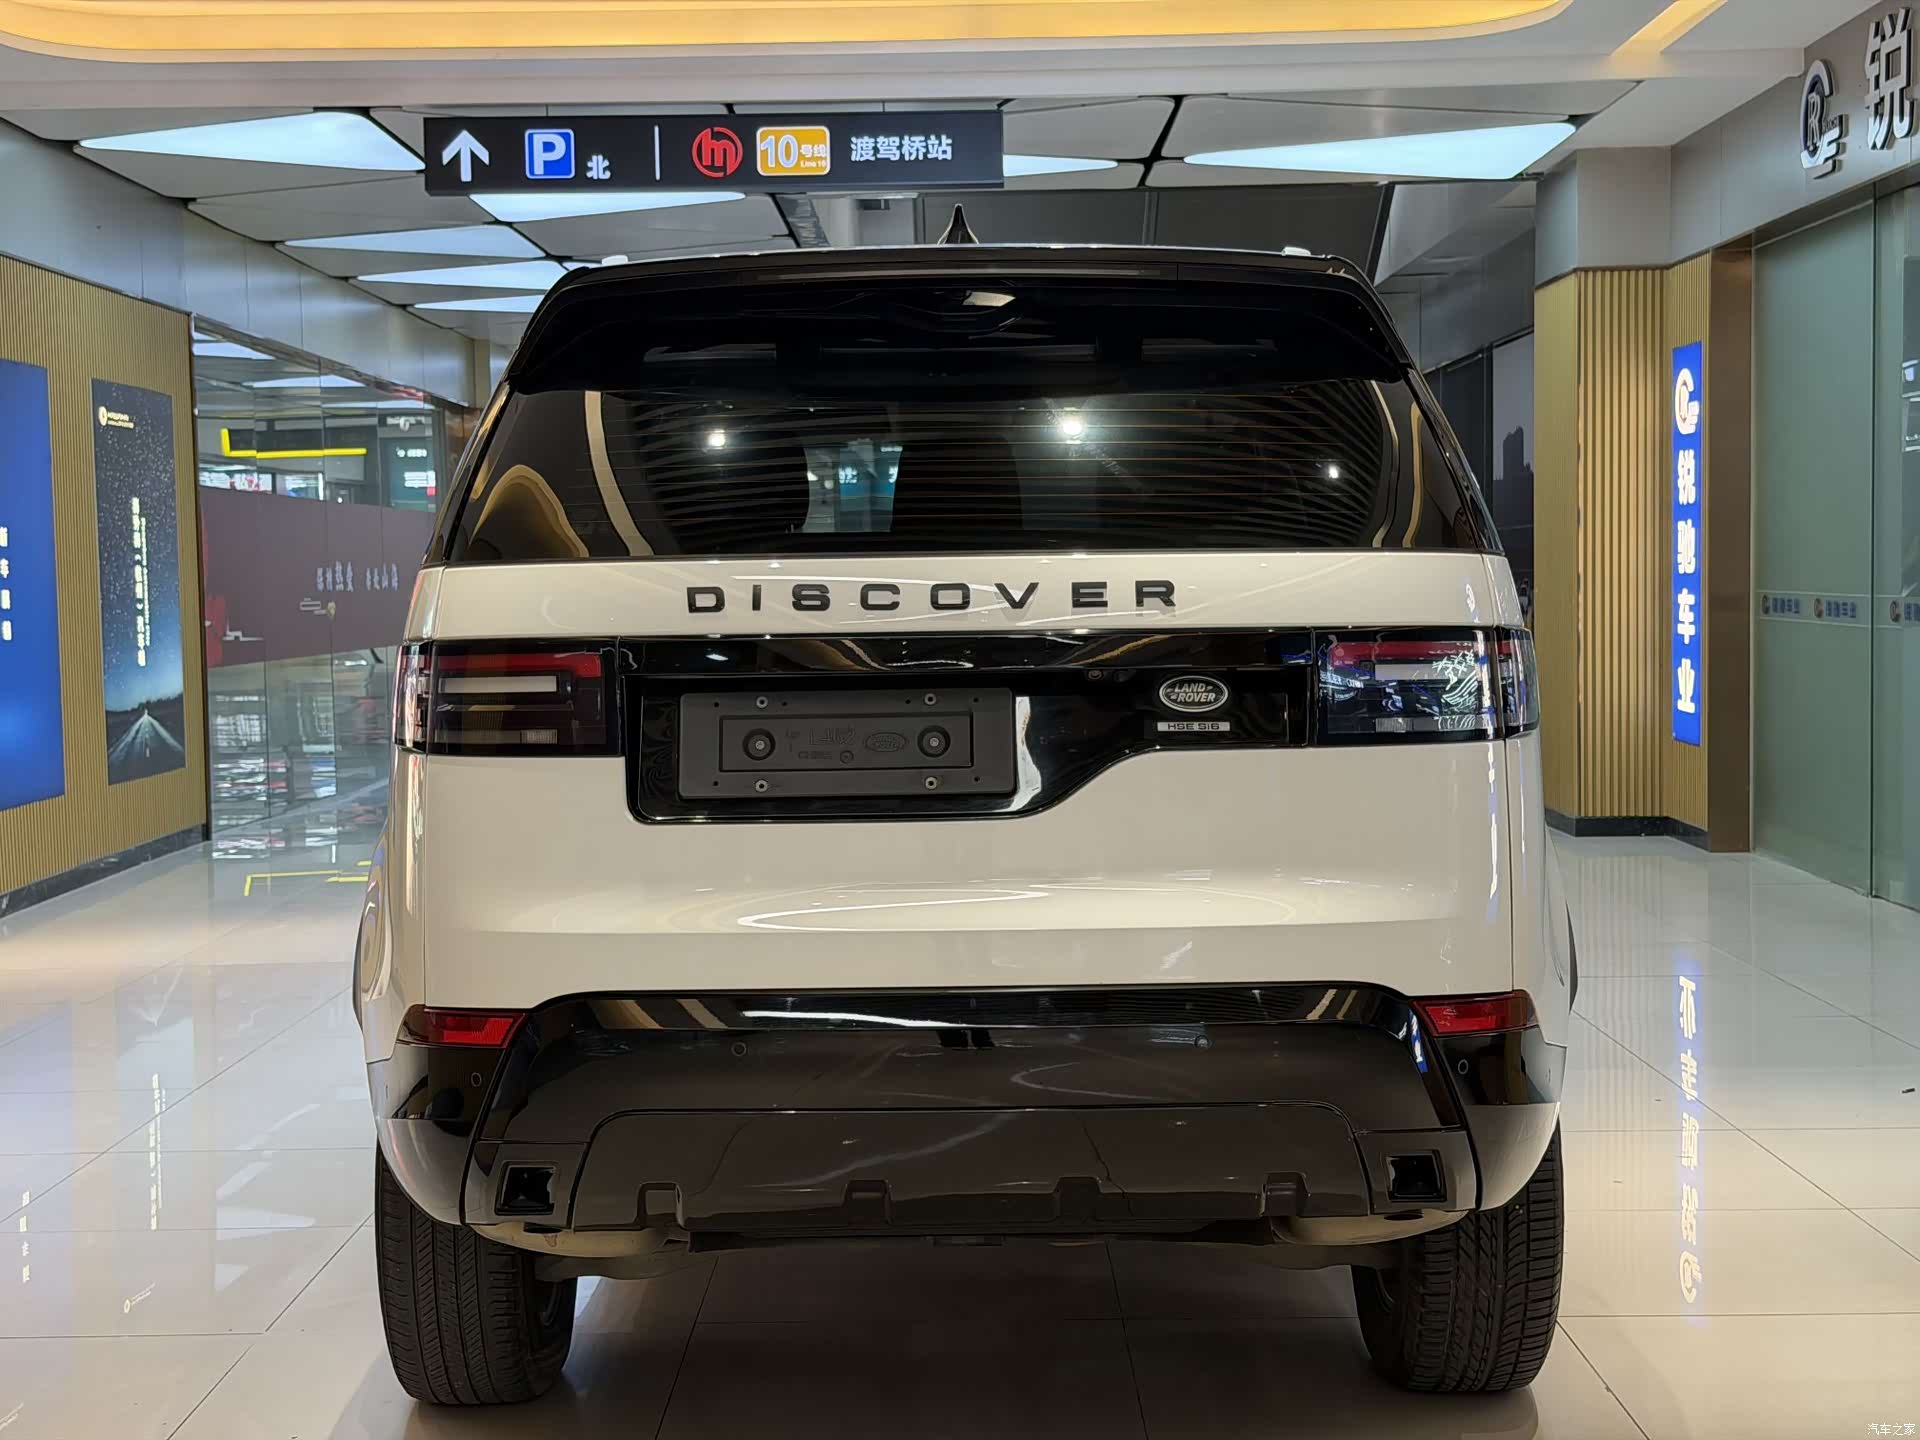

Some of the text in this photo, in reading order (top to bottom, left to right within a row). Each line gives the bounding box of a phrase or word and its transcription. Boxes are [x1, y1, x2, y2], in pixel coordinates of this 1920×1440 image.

[1865, 7, 1915, 150] 锐
[533, 133, 566, 175] P
[850, 134, 952, 162] 渡驾桥站
[586, 154, 611, 180] 北
[687, 579, 1176, 614] DISCOVER
[1677, 449, 1696, 713] 锐驰车业
[1174, 683, 1206, 692] LAND
[1177, 692, 1216, 702] ROVER
